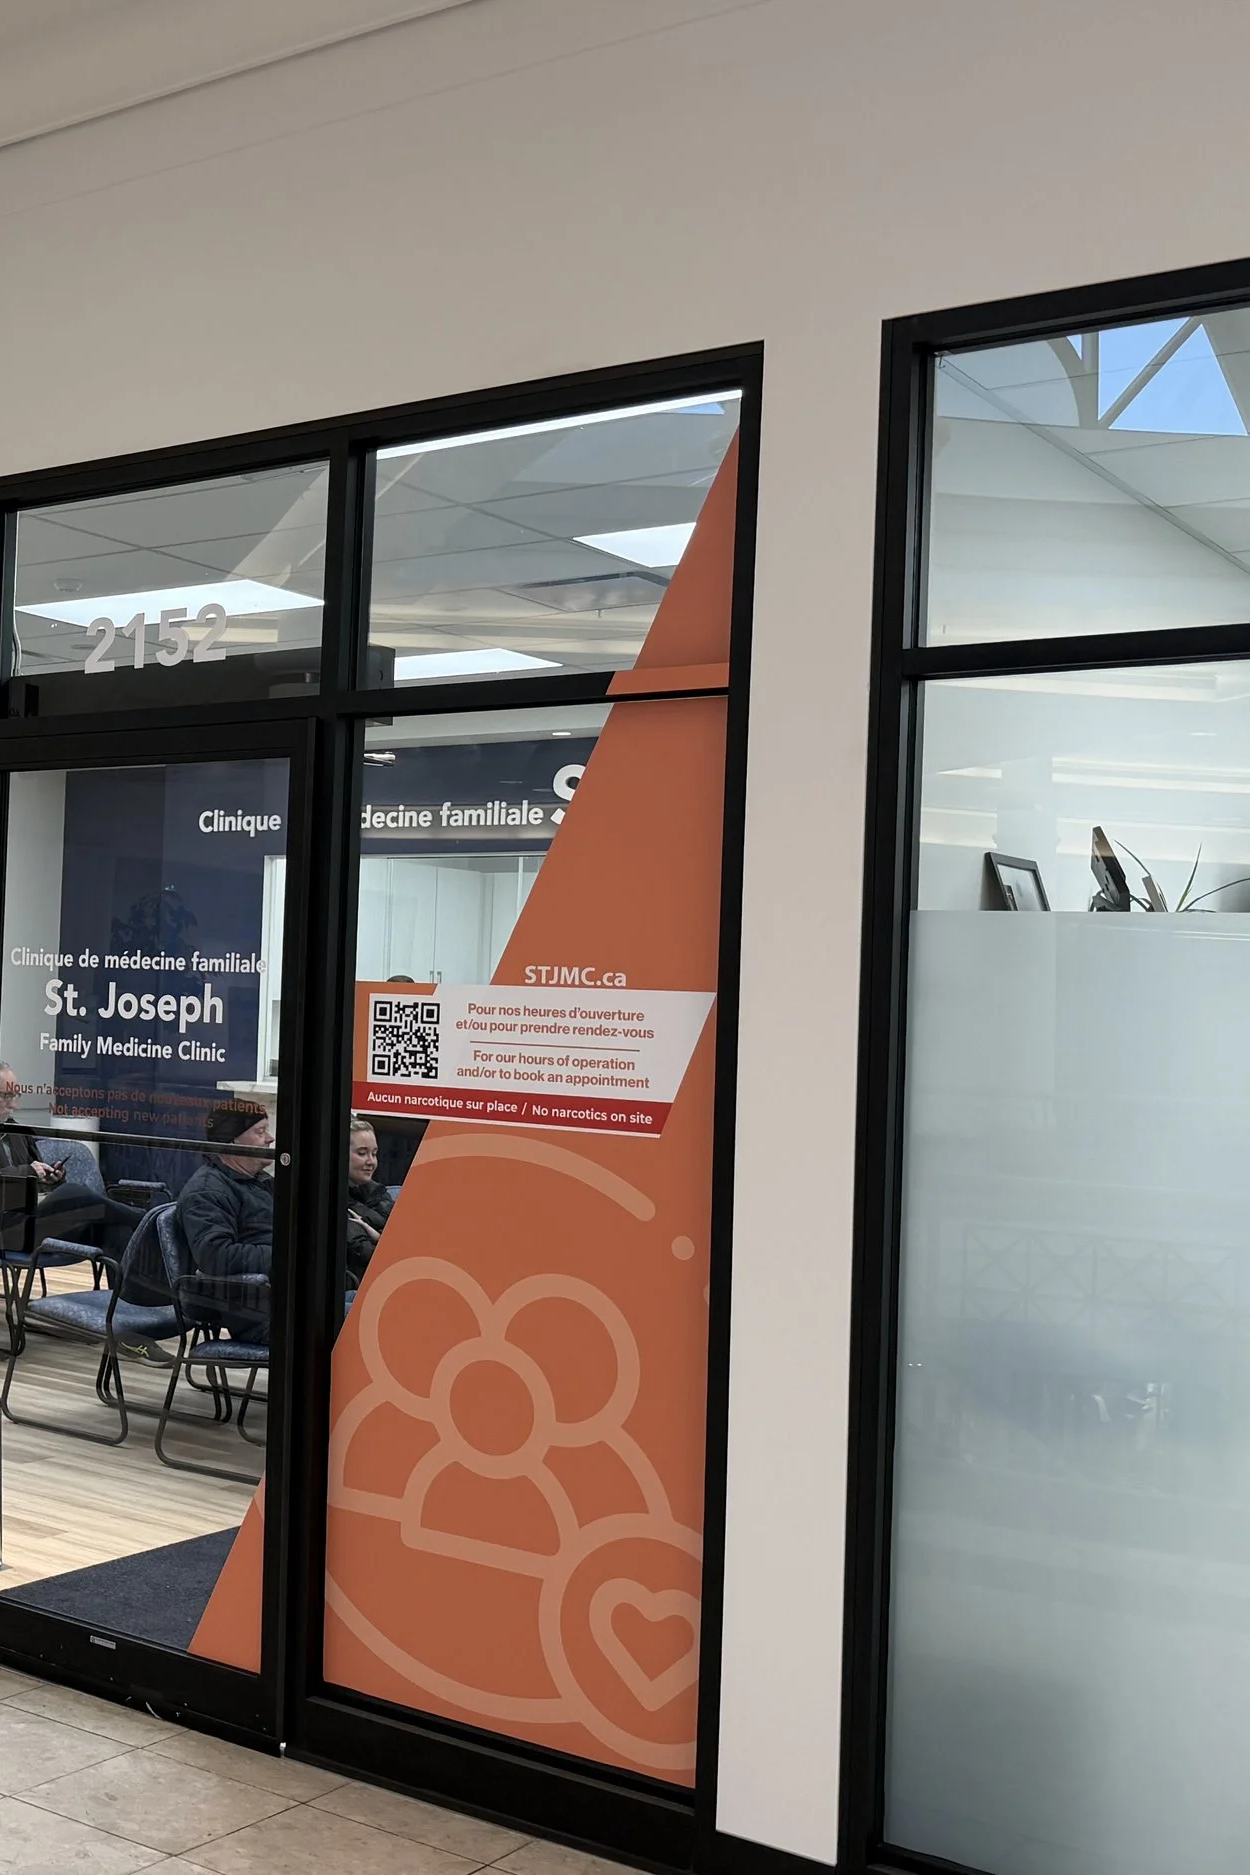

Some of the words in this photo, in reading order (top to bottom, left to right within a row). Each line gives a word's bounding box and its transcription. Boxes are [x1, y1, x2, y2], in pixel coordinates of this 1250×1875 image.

[84, 603, 227, 675] 2152
[198, 809, 282, 838] Clinique
[360, 804, 433, 829] decine
[439, 799, 544, 828] familiale
[10, 947, 74, 971] Clinique
[78, 948, 99, 968] de
[104, 950, 186, 971] médecine
[191, 951, 267, 973] familiale
[524, 965, 627, 987] STJMC.ca
[44, 978, 87, 1017] St.
[98, 981, 224, 1034] Joseph
[467, 1003, 497, 1016] Pour
[499, 1007, 521, 1017] nos
[523, 1005, 567, 1019] heures
[568, 1006, 645, 1022] d’ouverture
[455, 1018, 488, 1031] et/ou
[489, 1021, 518, 1034] pour
[520, 1021, 570, 1035] prendre
[572, 1024, 654, 1039] rendez-vous
[39, 1032, 91, 1059] Family
[97, 1036, 173, 1059] Medicine
[178, 1040, 226, 1063] Clinic
[473, 1050, 494, 1062] For
[495, 1053, 517, 1064] our
[518, 1052, 554, 1066] hours
[556, 1054, 570, 1066] of
[572, 1056, 636, 1071] operation
[456, 1066, 497, 1079] and/or
[499, 1068, 512, 1080] to
[513, 1069, 545, 1082] book
[547, 1074, 563, 1083] an
[565, 1074, 650, 1089] appointment
[6, 1081, 34, 1095] Nous
[107, 1091, 128, 1103] pas
[131, 1090, 146, 1101] de
[213, 1099, 267, 1114] patients
[367, 1091, 402, 1104] Aucun
[404, 1093, 464, 1110] narcotique
[466, 1100, 484, 1111] sur
[486, 1099, 518, 1113] place
[521, 1102, 528, 1116] /
[532, 1104, 549, 1117] No
[551, 1106, 607, 1121] narcotics
[610, 1112, 627, 1123] on
[629, 1111, 653, 1125] site
[48, 1103, 69, 1116] Not
[71, 1104, 129, 1122] accepting
[133, 1110, 159, 1123] new
